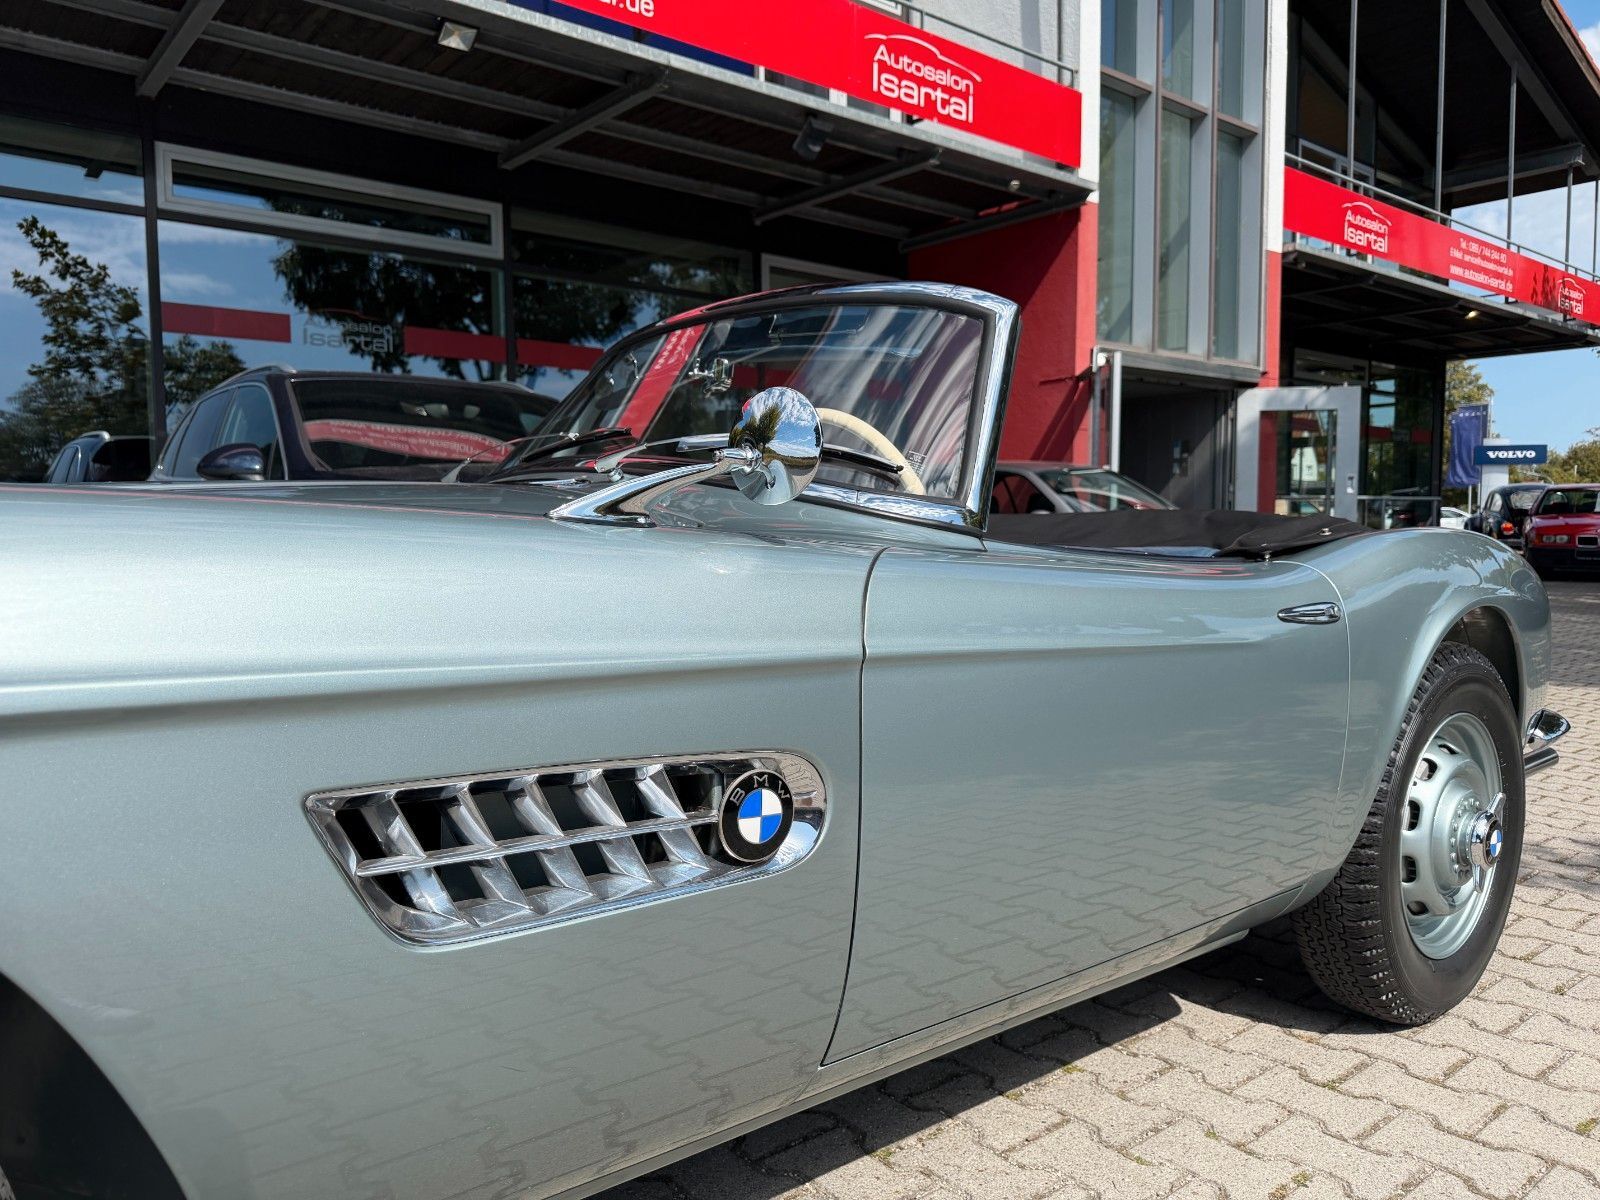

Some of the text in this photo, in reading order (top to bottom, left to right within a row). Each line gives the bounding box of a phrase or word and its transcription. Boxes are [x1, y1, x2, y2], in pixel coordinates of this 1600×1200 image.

[873, 44, 974, 95] Autosalon
[872, 61, 974, 123] Isartal
[1344, 220, 1388, 254] Isartal
[1346, 210, 1388, 234] Autosalon
[303, 328, 393, 353] Isartal
[1486, 450, 1536, 459] VOLVO
[730, 774, 791, 806] BMW
